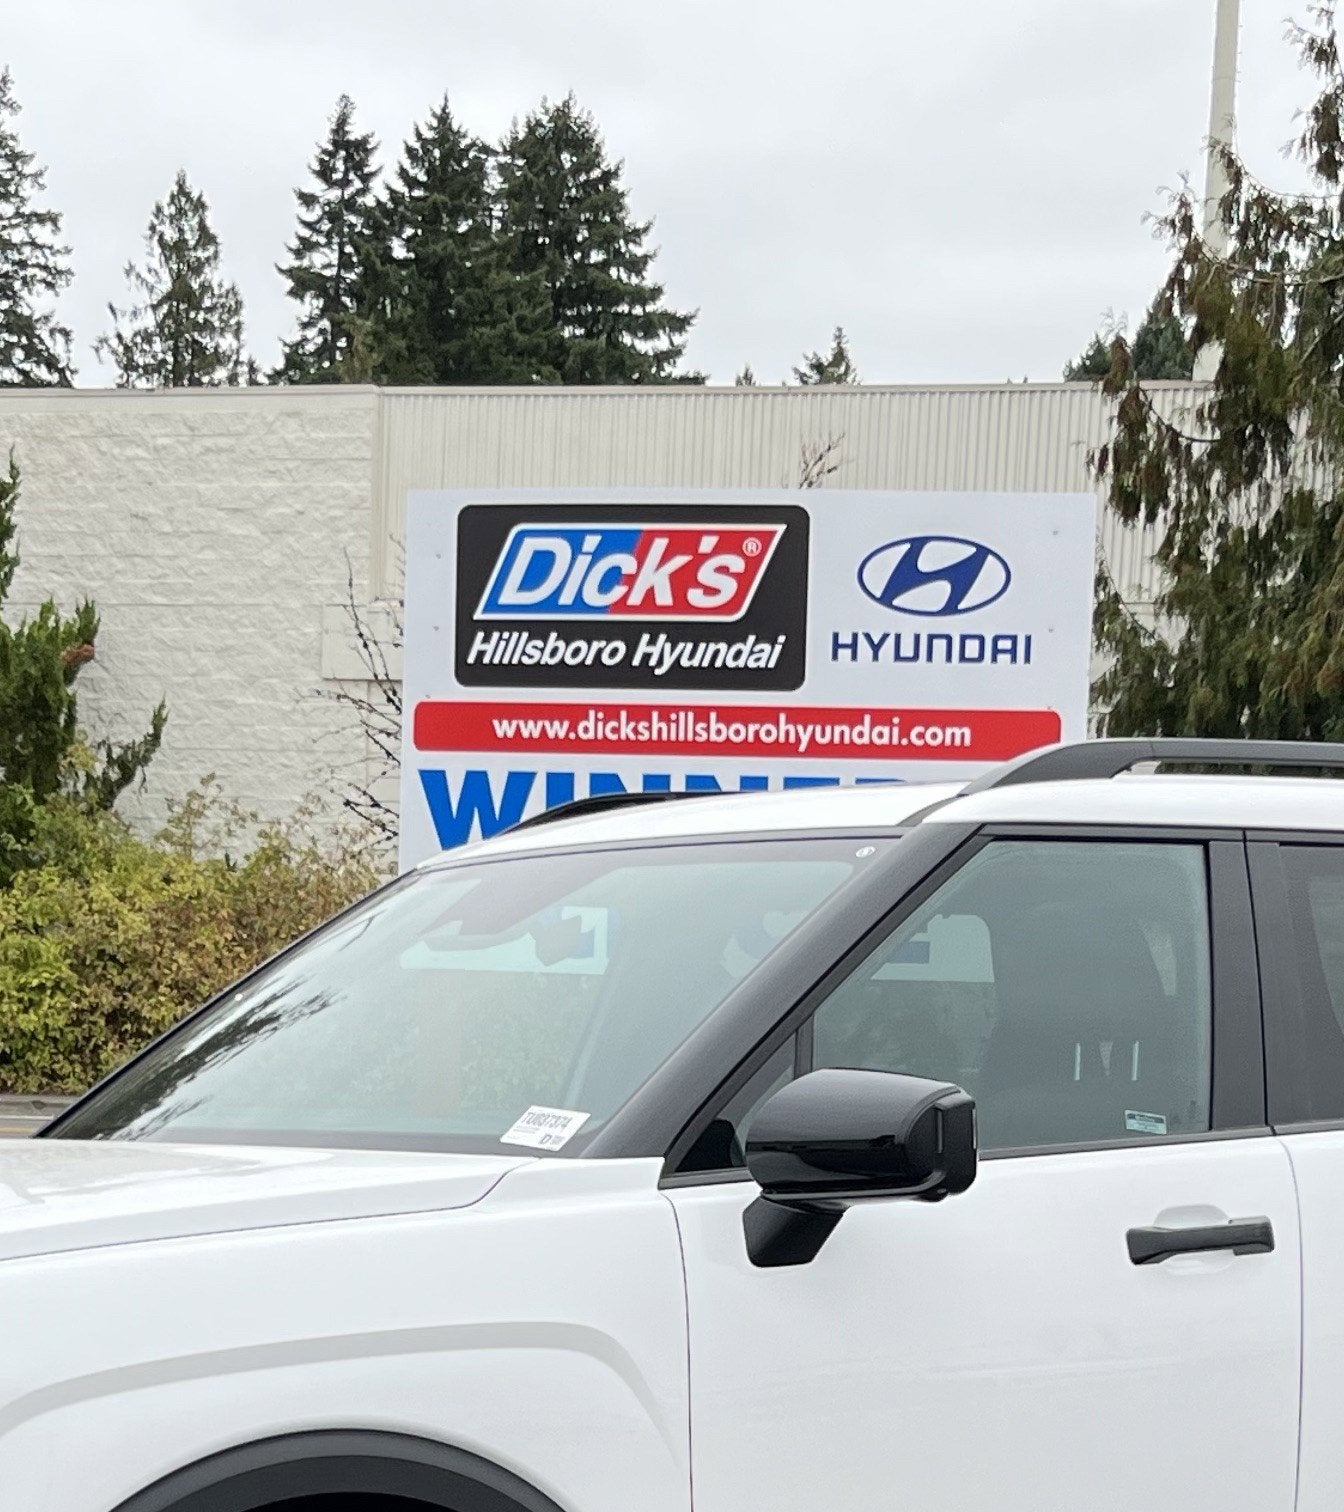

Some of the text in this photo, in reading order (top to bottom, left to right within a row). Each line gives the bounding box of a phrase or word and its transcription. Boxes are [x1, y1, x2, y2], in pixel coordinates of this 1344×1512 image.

[497, 535, 746, 608] Dick's
[466, 632, 786, 675] Hillsboro Hyundai
[831, 632, 1032, 665] HYUNDAI
[493, 709, 971, 754] www.dickshillsborohyundai.com
